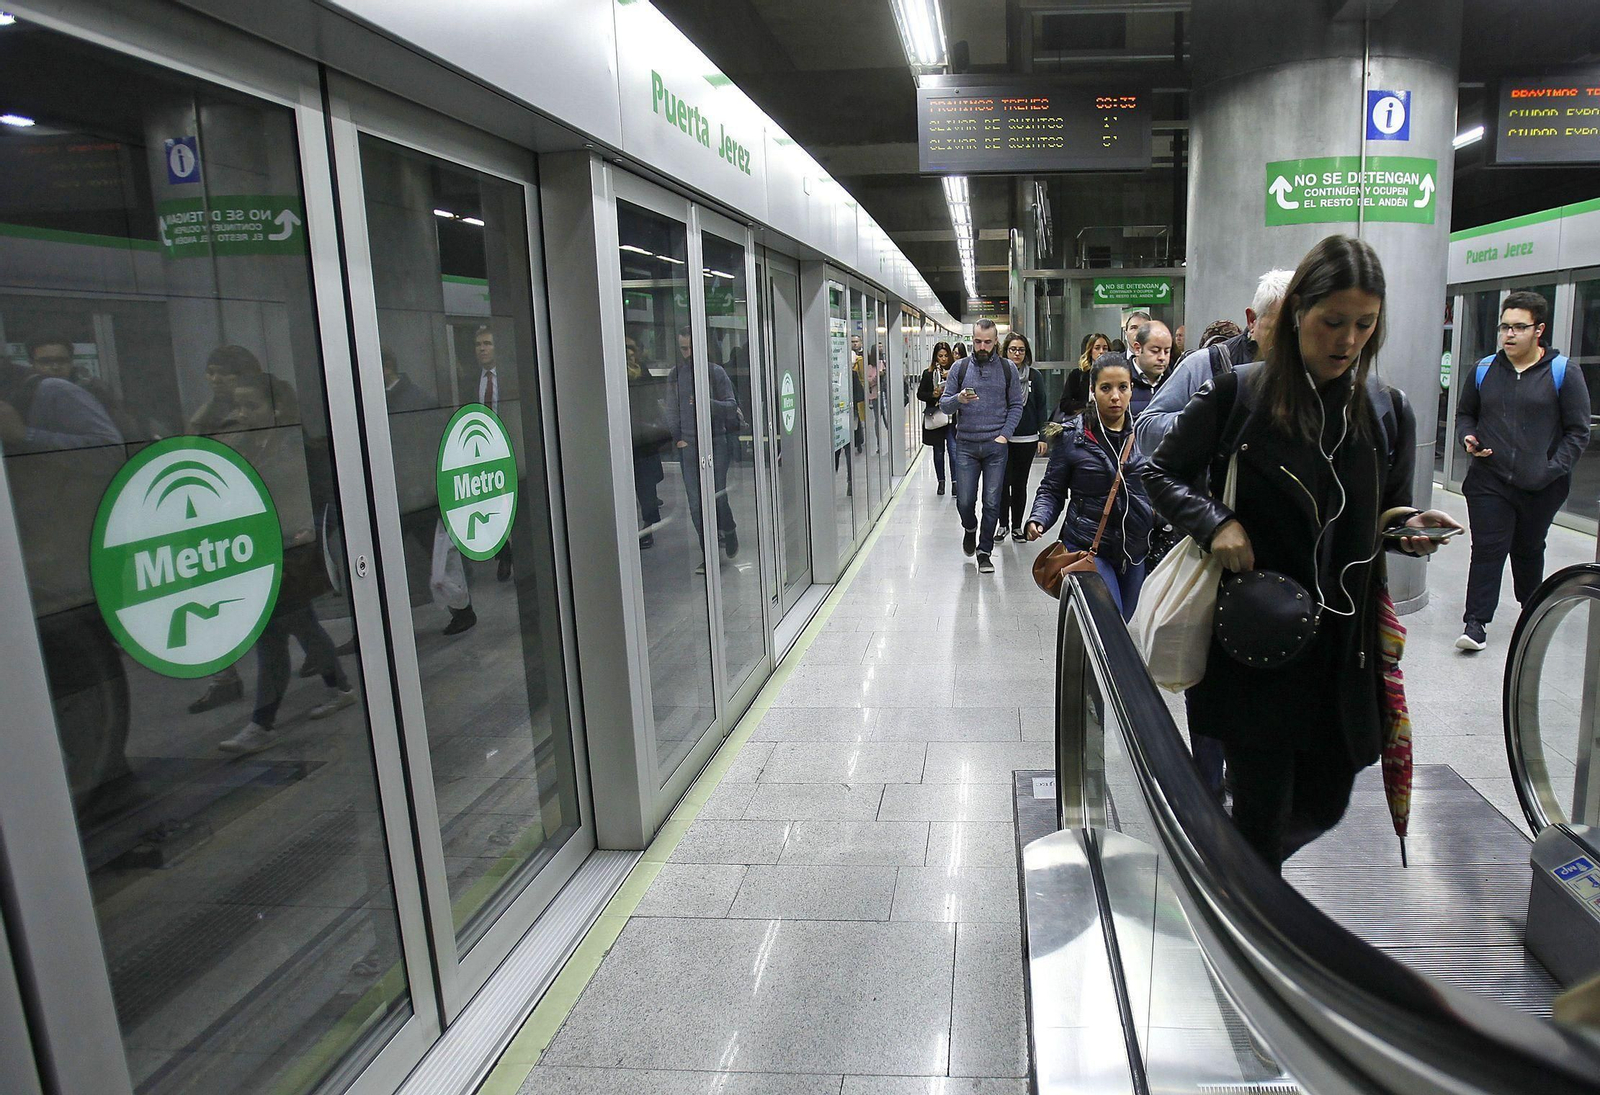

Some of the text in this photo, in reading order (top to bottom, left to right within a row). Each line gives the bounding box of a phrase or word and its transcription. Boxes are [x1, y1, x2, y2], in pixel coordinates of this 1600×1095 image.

[651, 69, 751, 176] Puerta Jerez
[1294, 171, 1419, 187] NO SE DETENGAN
[1304, 185, 1408, 197] CONTINÚEN Y OCUPEN
[1304, 199, 1316, 208] EL
[1320, 198, 1353, 207] RESTO
[1378, 197, 1408, 206] ANDÉN
[1466, 241, 1534, 265] Puerta Jerez
[453, 468, 505, 501] Metro
[133, 533, 254, 592] Metro
